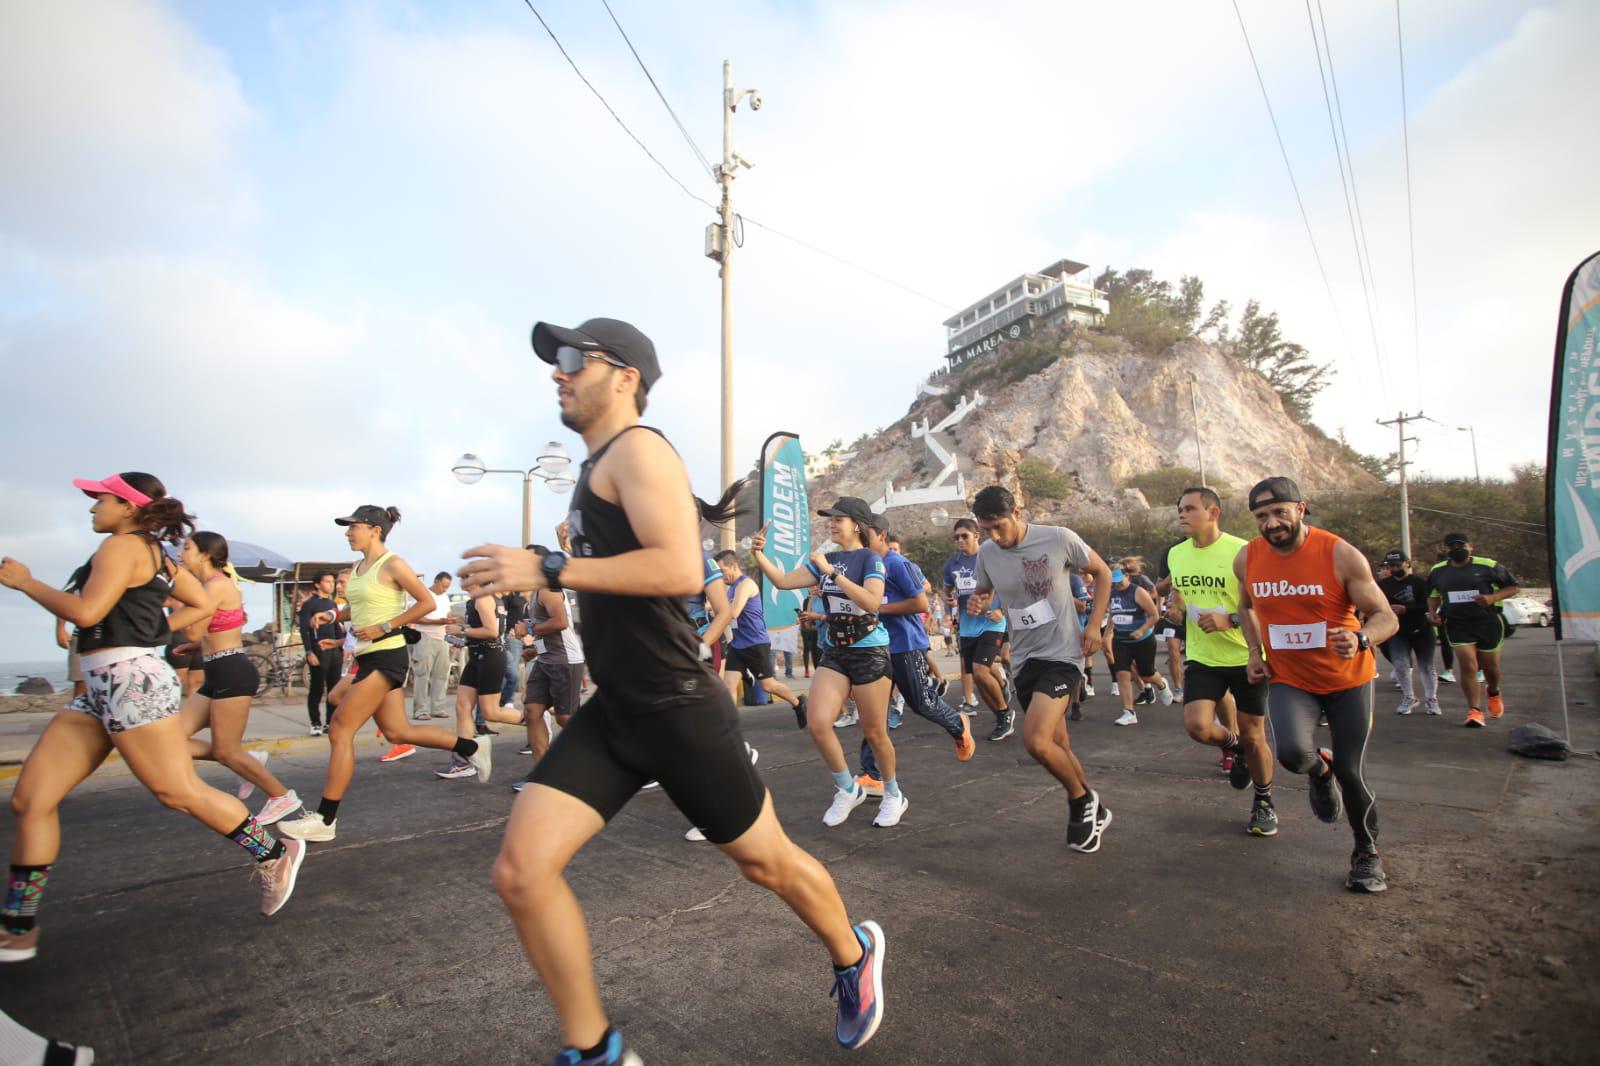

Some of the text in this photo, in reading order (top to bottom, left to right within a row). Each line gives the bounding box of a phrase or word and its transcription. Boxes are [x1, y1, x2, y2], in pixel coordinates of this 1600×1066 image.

[950, 333, 1003, 368] LA MAREA
[773, 461, 794, 555] IMDEM
[1175, 575, 1225, 588] LEGION
[1252, 580, 1325, 598] Wilson
[839, 602, 852, 612] 56
[1021, 614, 1036, 625] 61
[1284, 632, 1312, 644] 117
